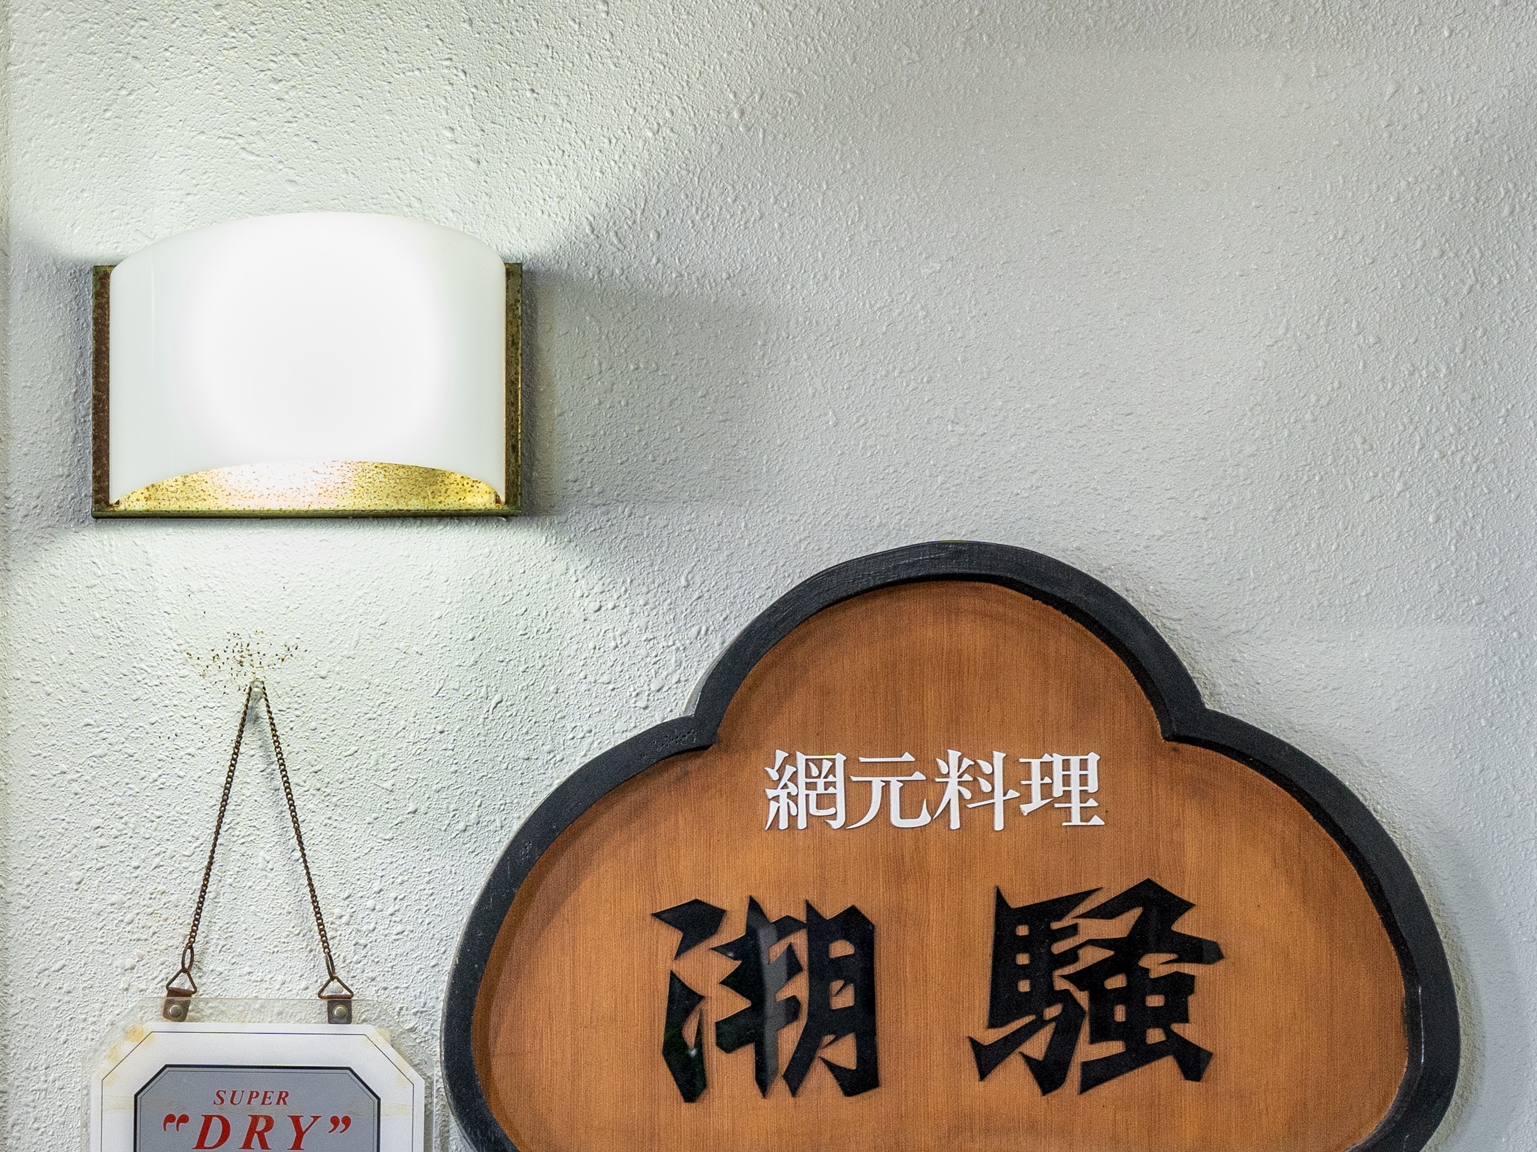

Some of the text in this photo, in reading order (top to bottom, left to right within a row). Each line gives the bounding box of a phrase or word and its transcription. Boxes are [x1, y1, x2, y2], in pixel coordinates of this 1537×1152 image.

[764, 750, 1106, 831] 網元料理
[213, 1089, 290, 1106] SUPER
